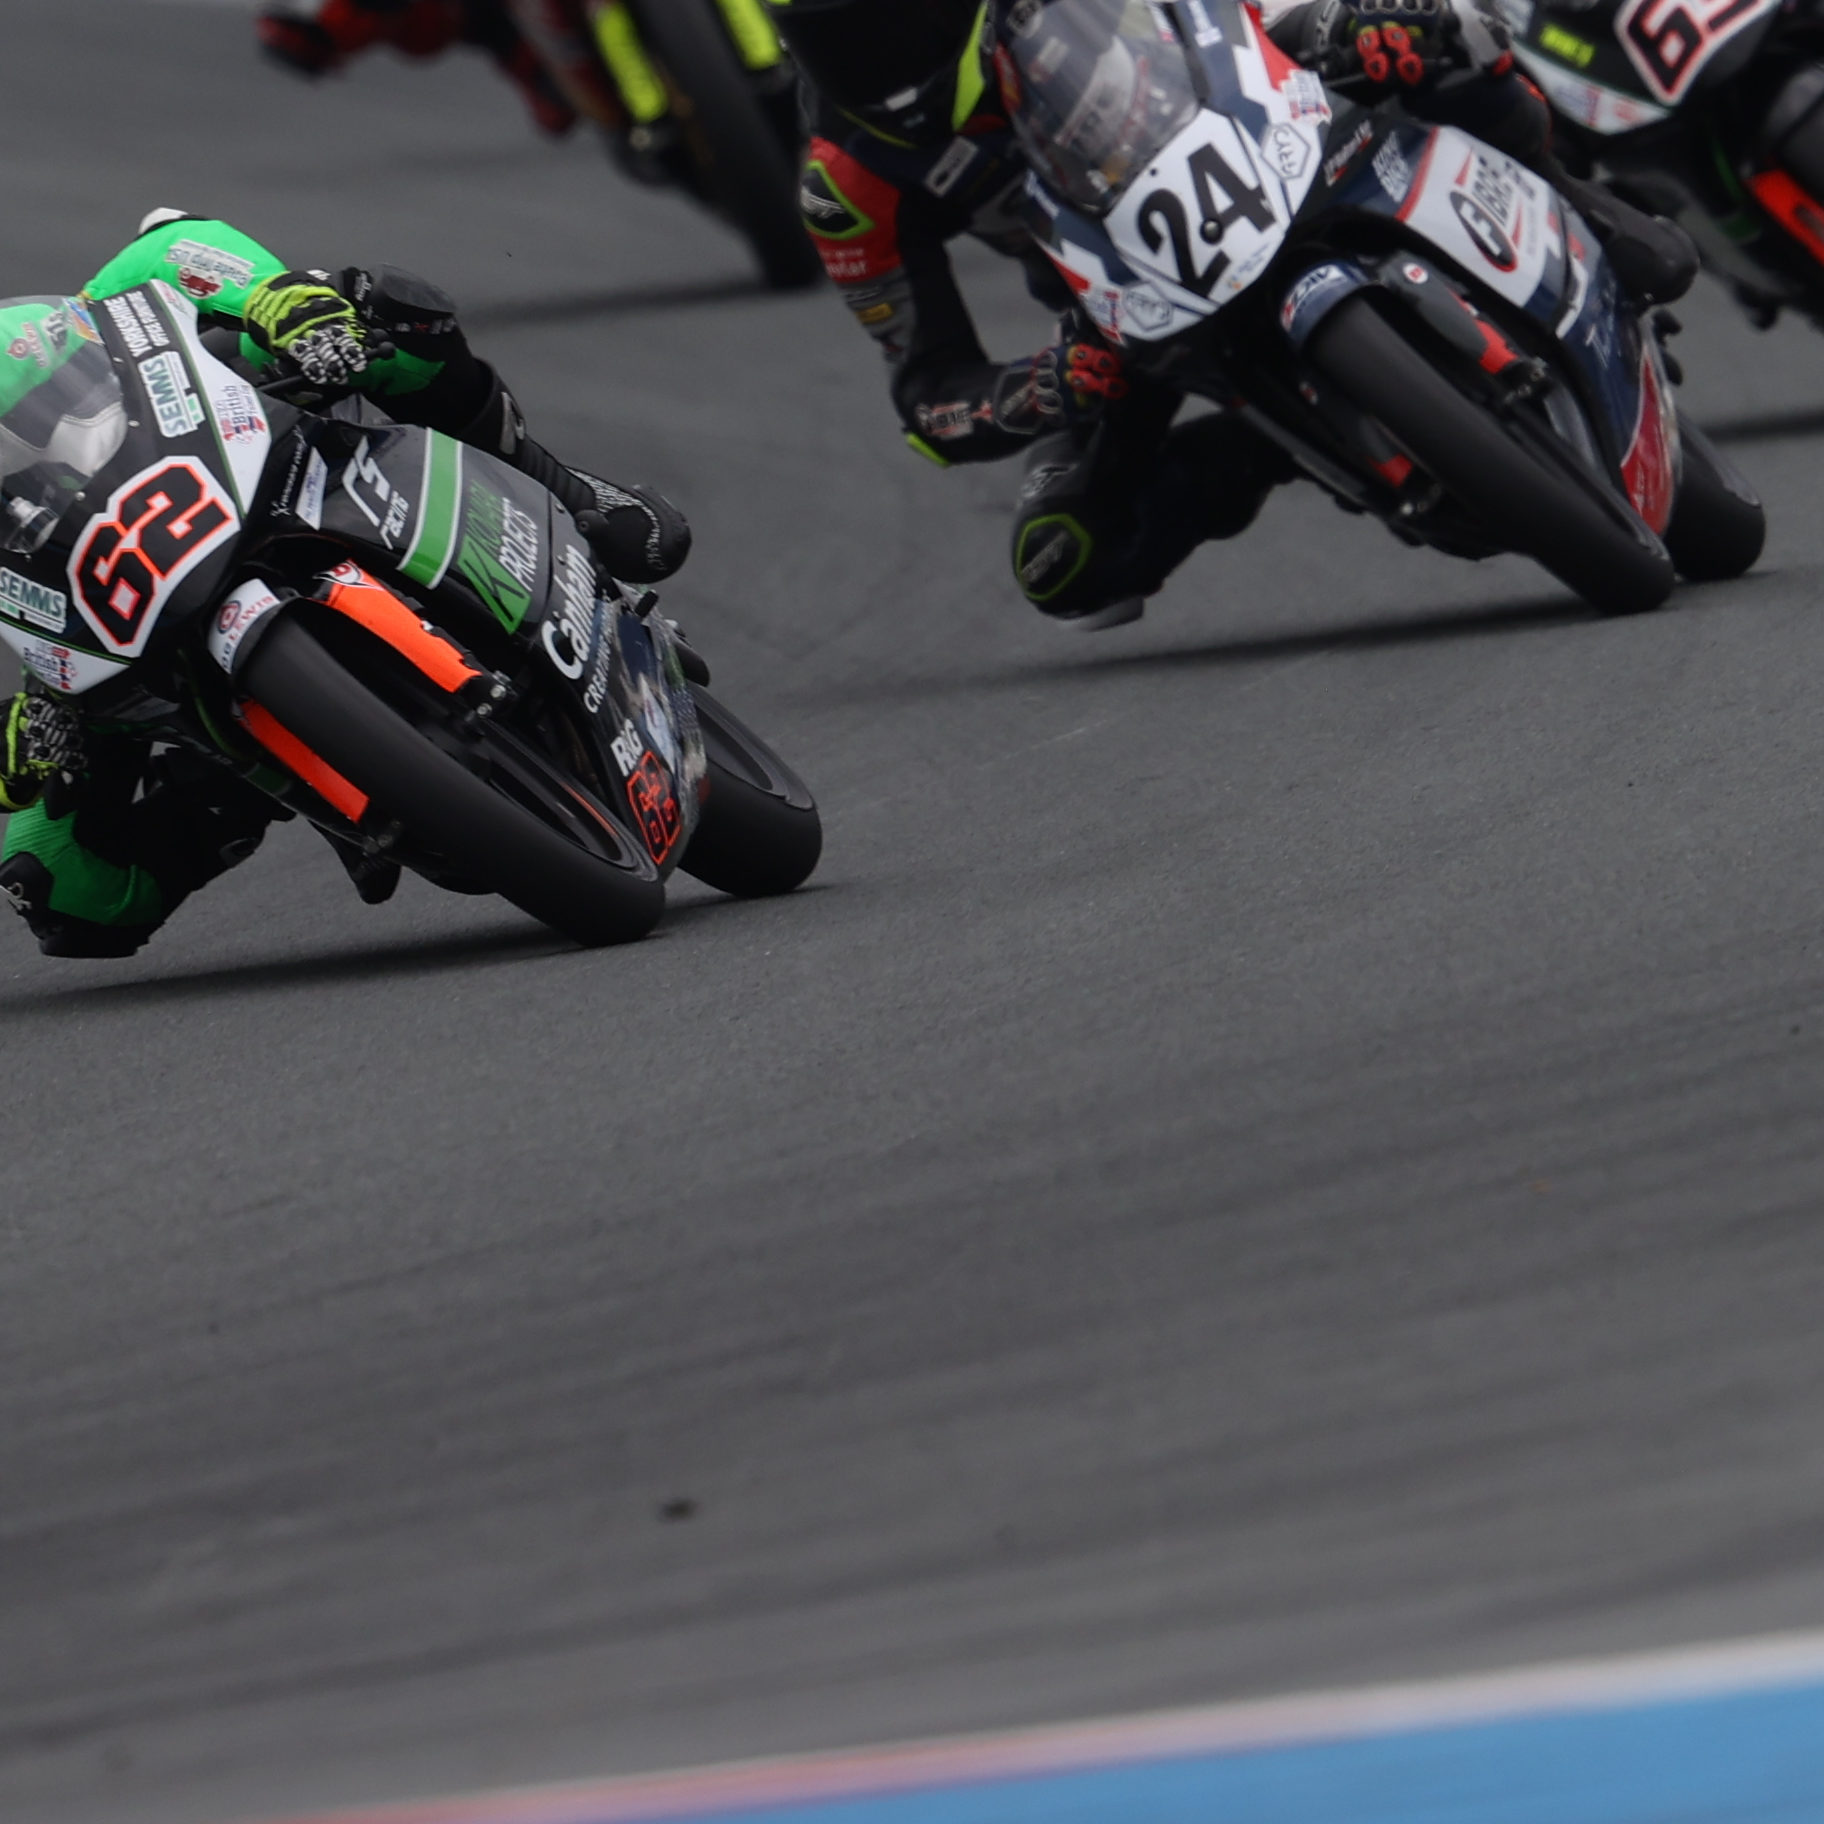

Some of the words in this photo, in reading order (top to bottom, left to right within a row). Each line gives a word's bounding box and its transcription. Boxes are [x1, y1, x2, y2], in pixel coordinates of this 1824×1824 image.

[1137, 142, 1278, 299] 24
[76, 463, 236, 647] 62
[627, 750, 682, 865] 62
